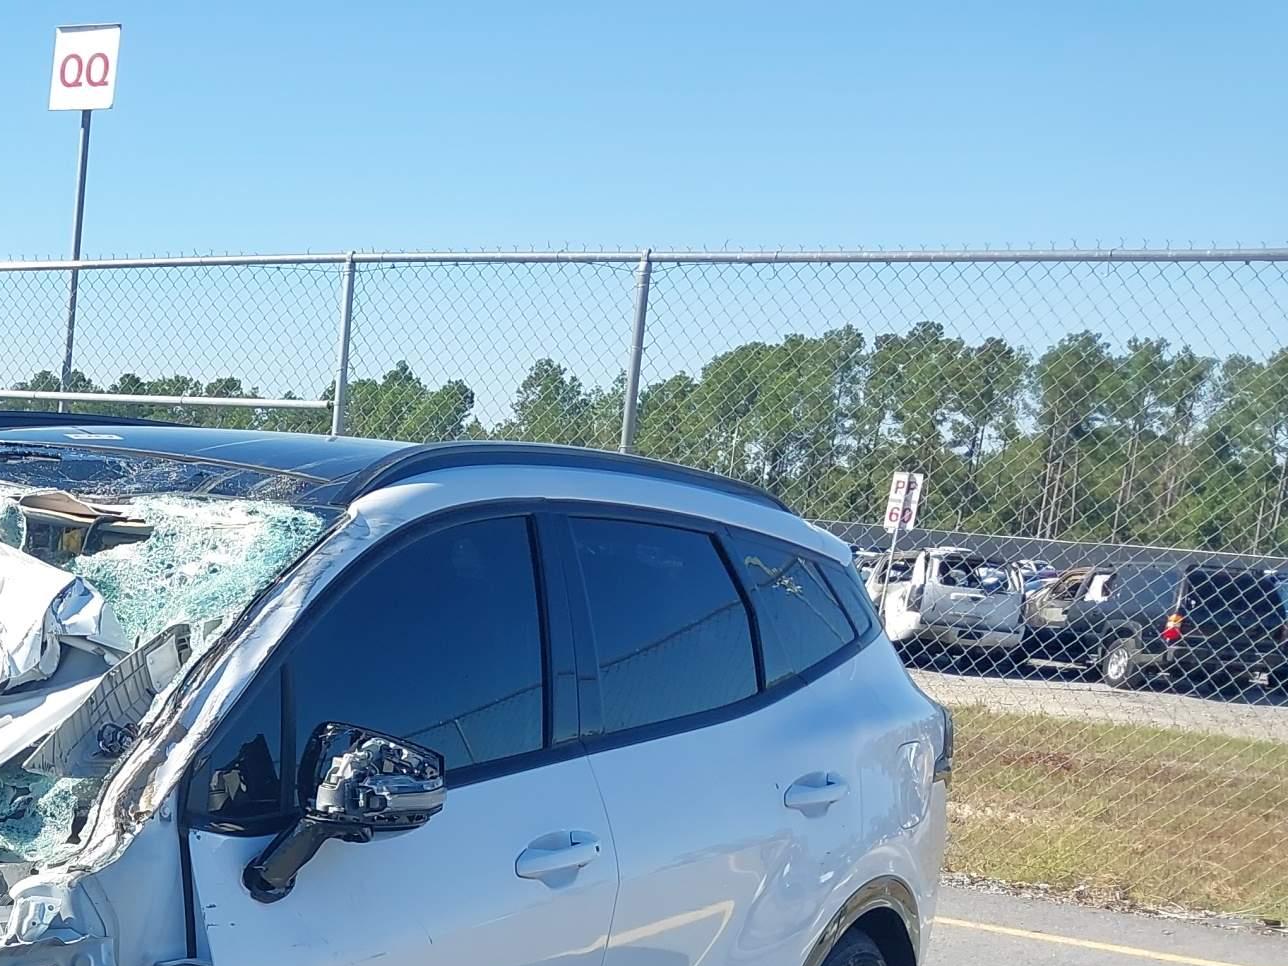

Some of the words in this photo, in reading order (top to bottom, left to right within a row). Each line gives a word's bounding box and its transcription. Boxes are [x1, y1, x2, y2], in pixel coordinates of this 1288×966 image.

[59, 52, 110, 88] QQ
[894, 480, 918, 494] PP
[888, 506, 913, 523] 60
